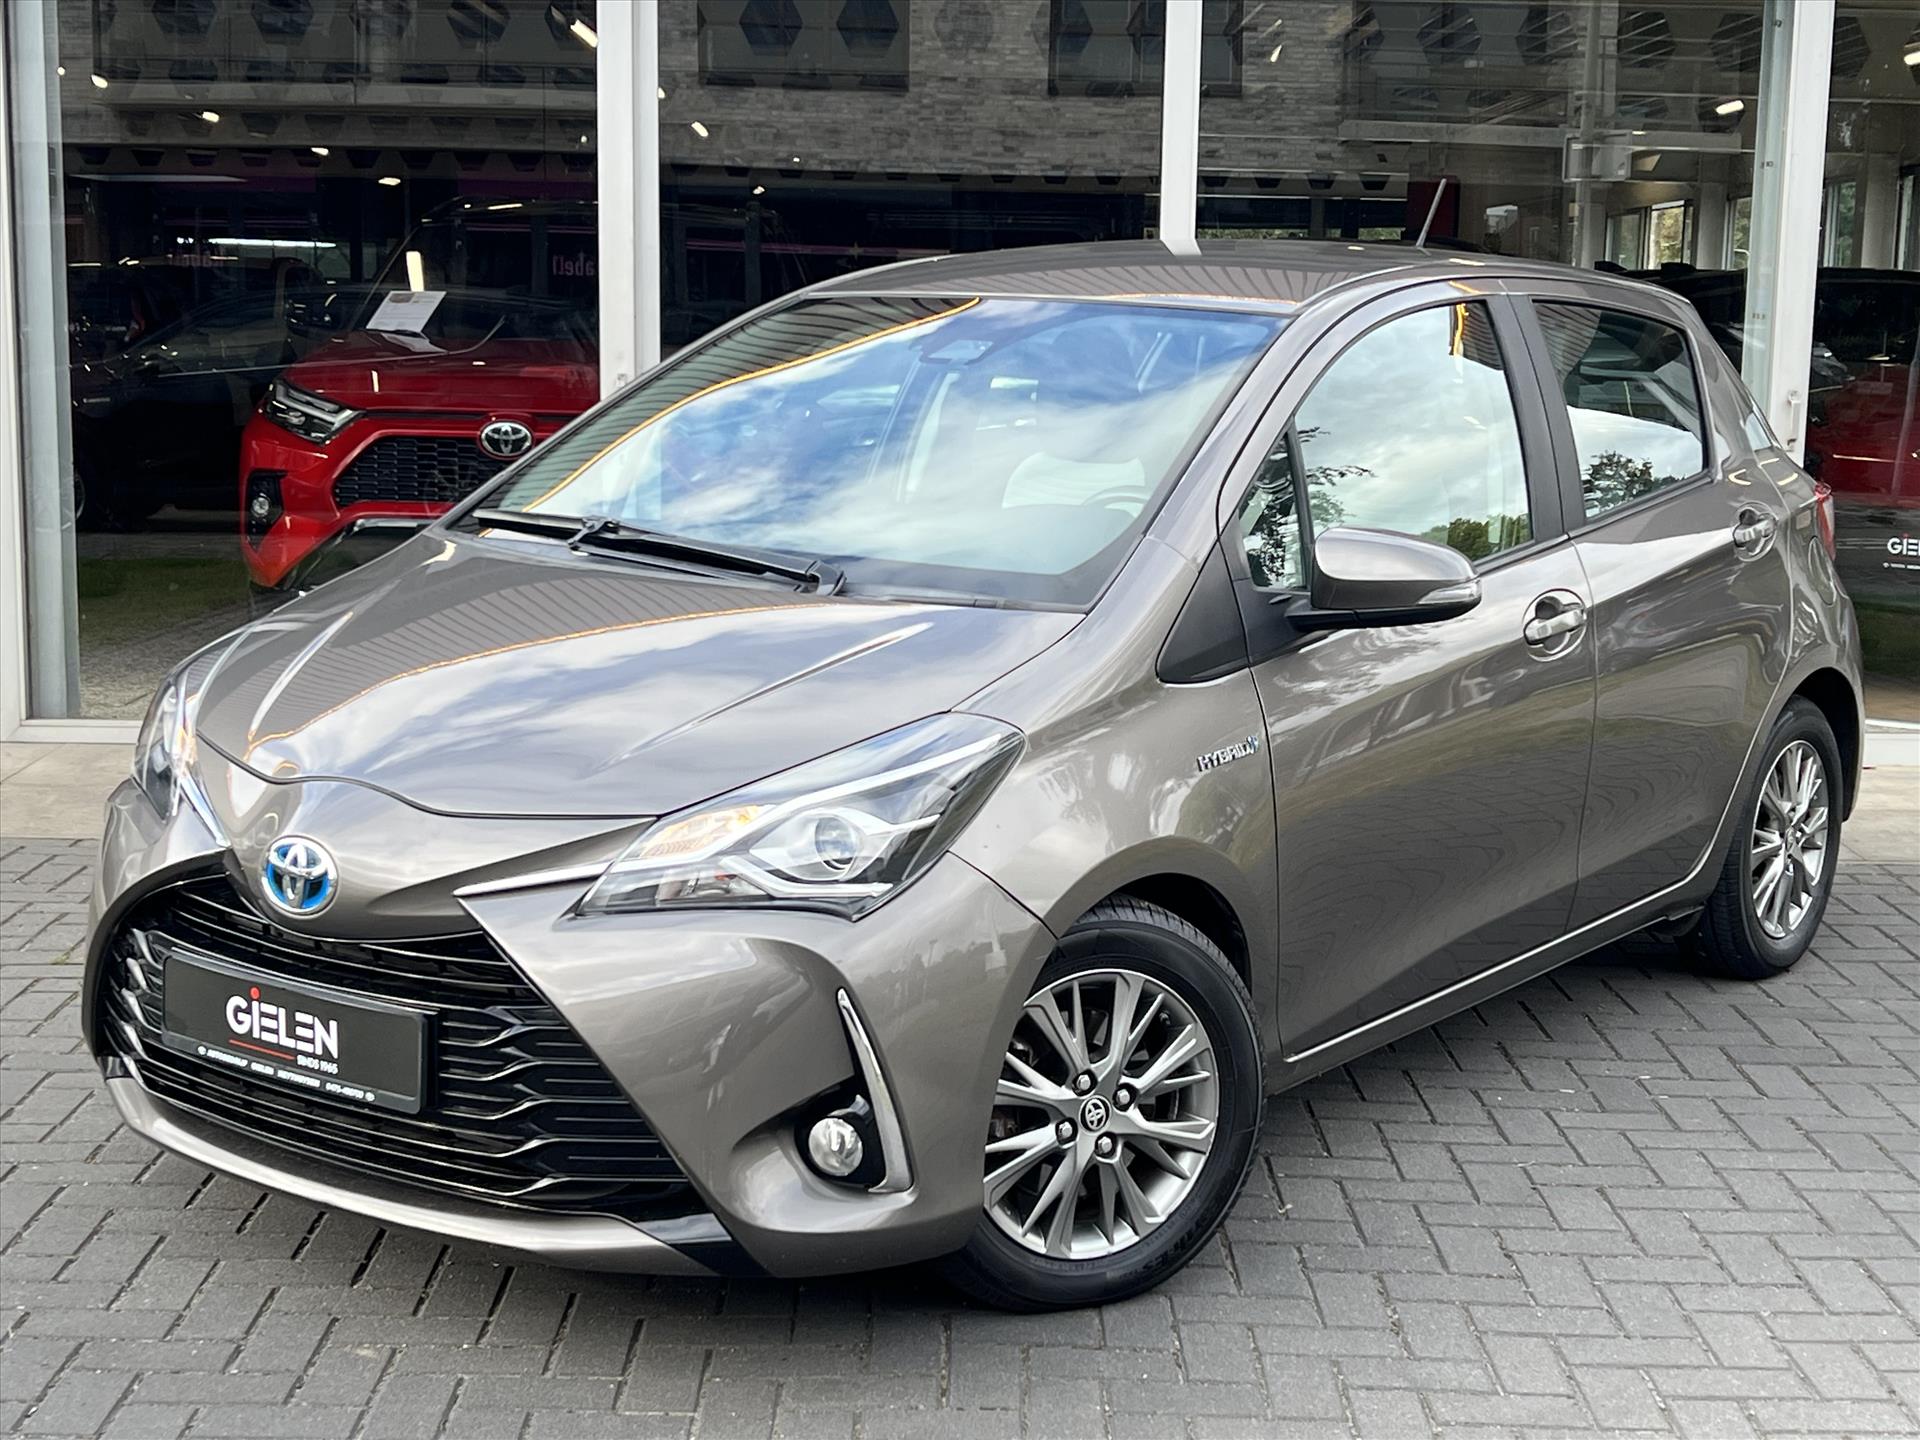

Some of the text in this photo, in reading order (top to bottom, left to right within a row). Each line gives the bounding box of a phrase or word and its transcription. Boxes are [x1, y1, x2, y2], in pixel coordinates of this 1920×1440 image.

[1887, 533, 1920, 556] GIE
[1197, 742, 1250, 772] HYBRID
[226, 987, 339, 1060] GIELEN
[320, 1061, 339, 1075] 1965
